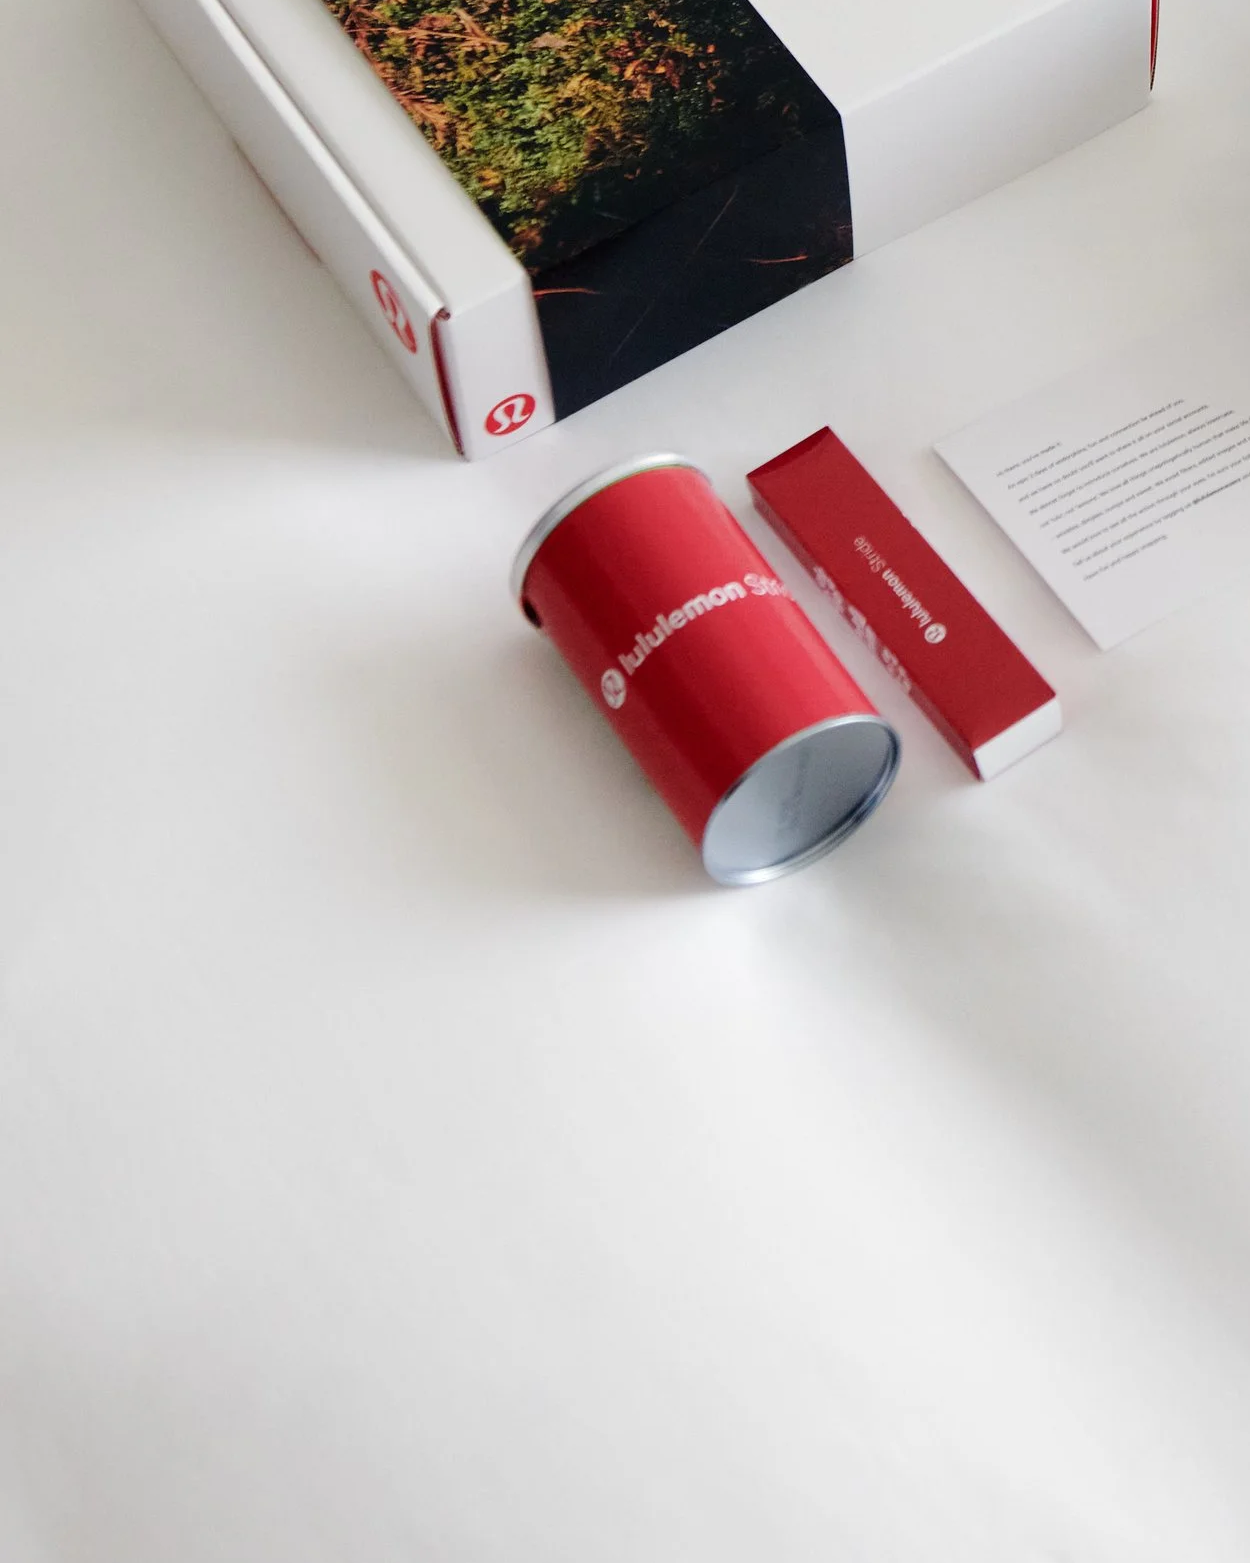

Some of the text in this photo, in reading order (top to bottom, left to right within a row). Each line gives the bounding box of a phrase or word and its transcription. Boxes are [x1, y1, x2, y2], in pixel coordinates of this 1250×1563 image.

[617, 581, 747, 676] lululemon
[853, 535, 933, 628] lululemon Stride
